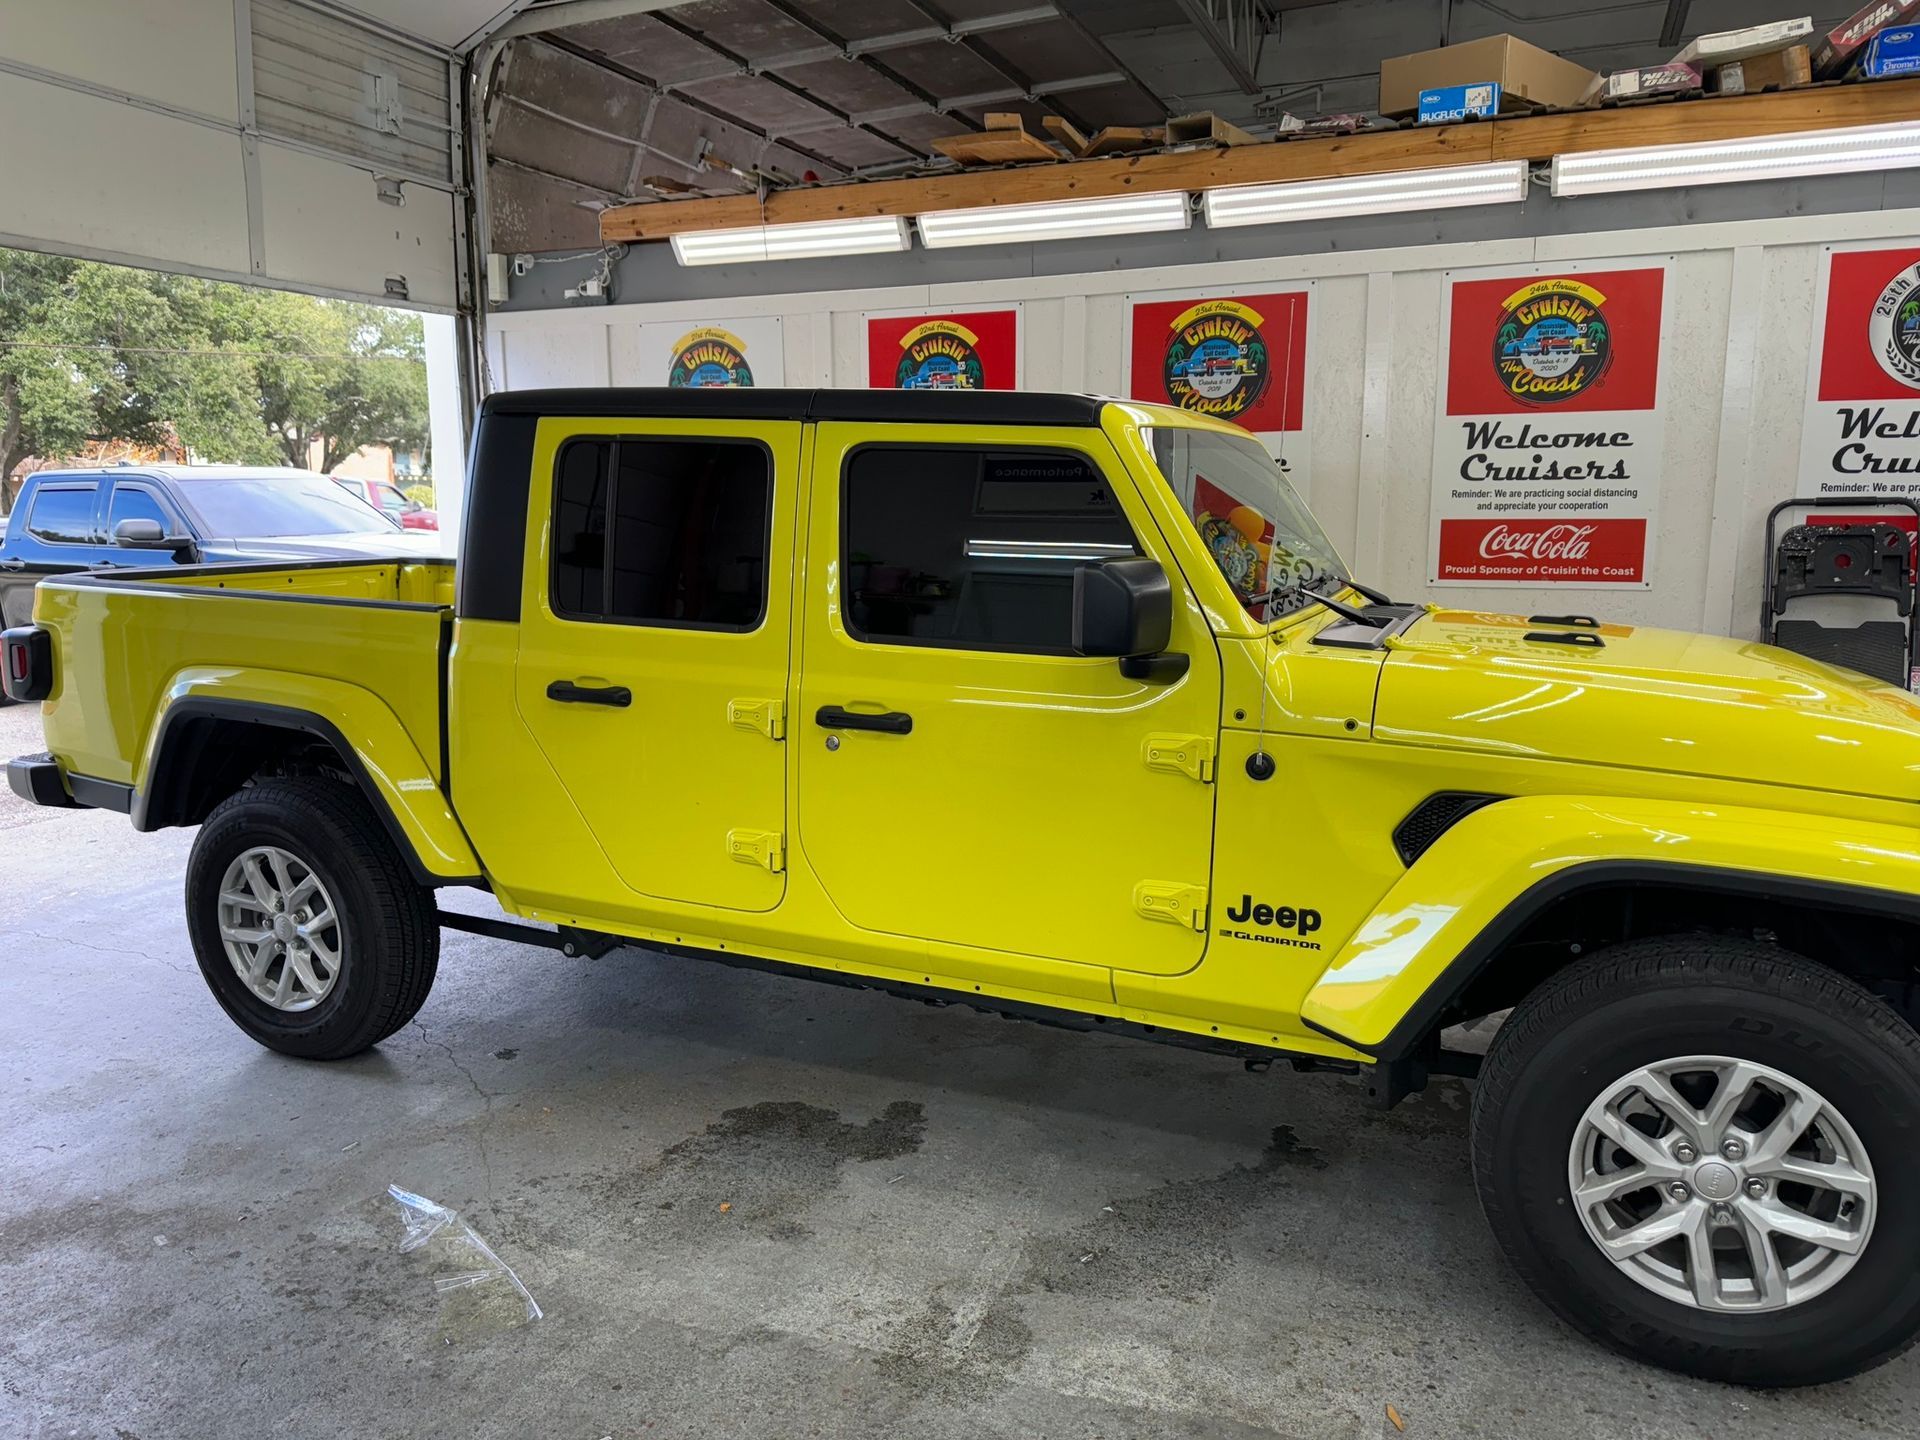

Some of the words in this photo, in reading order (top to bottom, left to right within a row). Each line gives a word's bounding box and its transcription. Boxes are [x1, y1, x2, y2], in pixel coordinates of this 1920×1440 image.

[1529, 283, 1550, 295] 24th
[1552, 281, 1581, 293] Annual
[1876, 279, 1911, 316] 25th
[1195, 304, 1213, 316] 23rd
[1215, 302, 1241, 314] Annual
[1501, 360, 1523, 374] The
[1170, 382, 1191, 395] The
[1511, 366, 1585, 393] Coast
[1180, 386, 1246, 413] Coast
[1836, 407, 1920, 439] Wel
[1462, 421, 1634, 450] Welcome
[1460, 453, 1631, 481] Cruisers
[1832, 442, 1920, 474] Cru
[1451, 489, 1493, 499] Reminder:
[1494, 489, 1507, 498] We
[1508, 490, 1522, 498] are
[1523, 488, 1565, 500] practicing
[1566, 488, 1592, 498] social
[1593, 487, 1638, 499] distancing
[1820, 482, 1870, 492] Reminder:
[1872, 482, 1888, 492] We
[1889, 484, 1906, 492] are
[1476, 501, 1492, 510] and
[1493, 501, 1536, 512] appreciate
[1537, 502, 1556, 512] your
[1558, 500, 1609, 511] cooperation
[1445, 564, 1476, 574] Proud
[1479, 565, 1524, 576] Sponsor
[1526, 565, 1538, 574] of
[1581, 566, 1599, 575] the
[1602, 566, 1634, 576] Coast
[1227, 894, 1322, 936] Jeep
[1234, 931, 1322, 951] GLADIATOR
